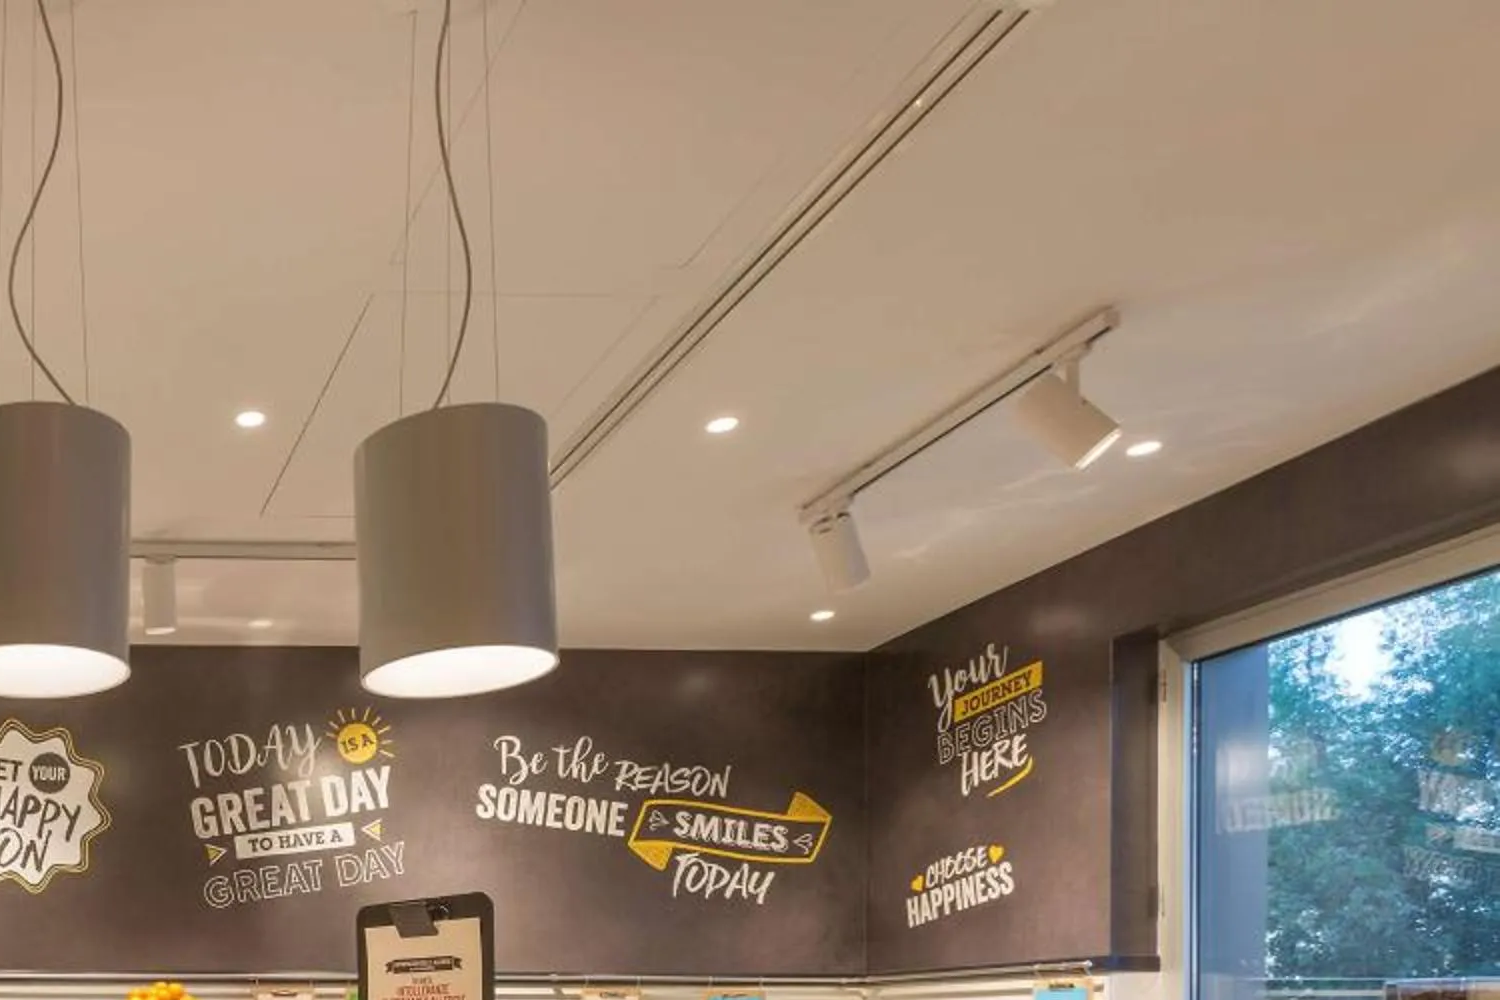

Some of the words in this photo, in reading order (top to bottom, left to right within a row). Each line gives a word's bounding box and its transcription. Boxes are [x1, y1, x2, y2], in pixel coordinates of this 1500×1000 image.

[928, 643, 1008, 732] Your
[962, 669, 1034, 716] JOURNEY
[177, 722, 323, 787] TODAY
[937, 690, 1047, 765] BEGINS
[30, 766, 66, 782] YOUR
[493, 735, 548, 784] Be
[553, 735, 609, 783] the
[614, 760, 731, 798] REASON
[960, 734, 1029, 796] HERE
[190, 780, 320, 839] GREAT
[321, 766, 392, 817] DAY
[476, 783, 629, 837] SOMEONE
[673, 810, 788, 853] SMILES
[248, 837, 272, 853] TO
[278, 831, 324, 851] HAVE
[329, 829, 343, 845] A
[925, 845, 988, 888] CHOOSE
[203, 860, 323, 909] GREAT
[335, 842, 406, 888] DAY
[671, 851, 775, 905] TODAY
[906, 861, 1014, 929] HAPPINESS
